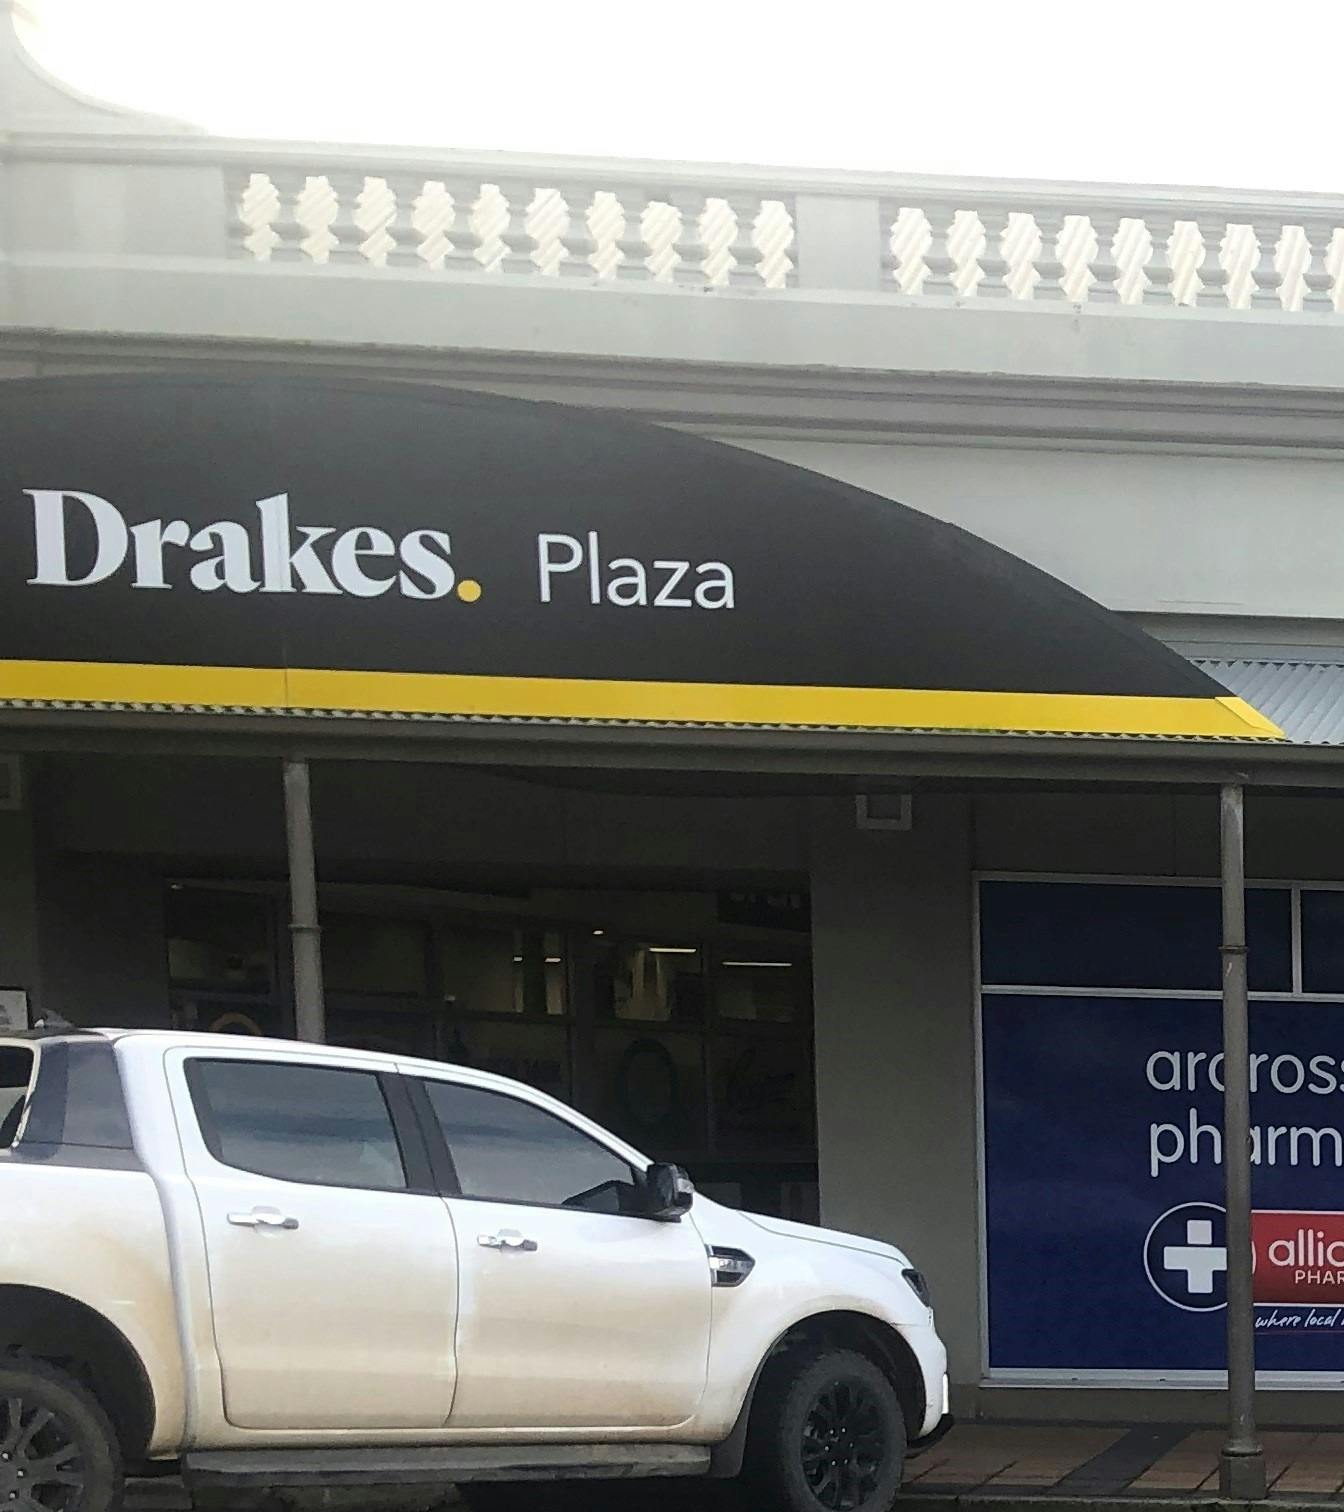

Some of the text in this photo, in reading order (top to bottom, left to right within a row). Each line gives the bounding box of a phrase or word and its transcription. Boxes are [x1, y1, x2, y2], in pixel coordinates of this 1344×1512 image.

[538, 530, 736, 610] Plaza
[1255, 1309, 1301, 1328] where
[1304, 1308, 1337, 1327] local
